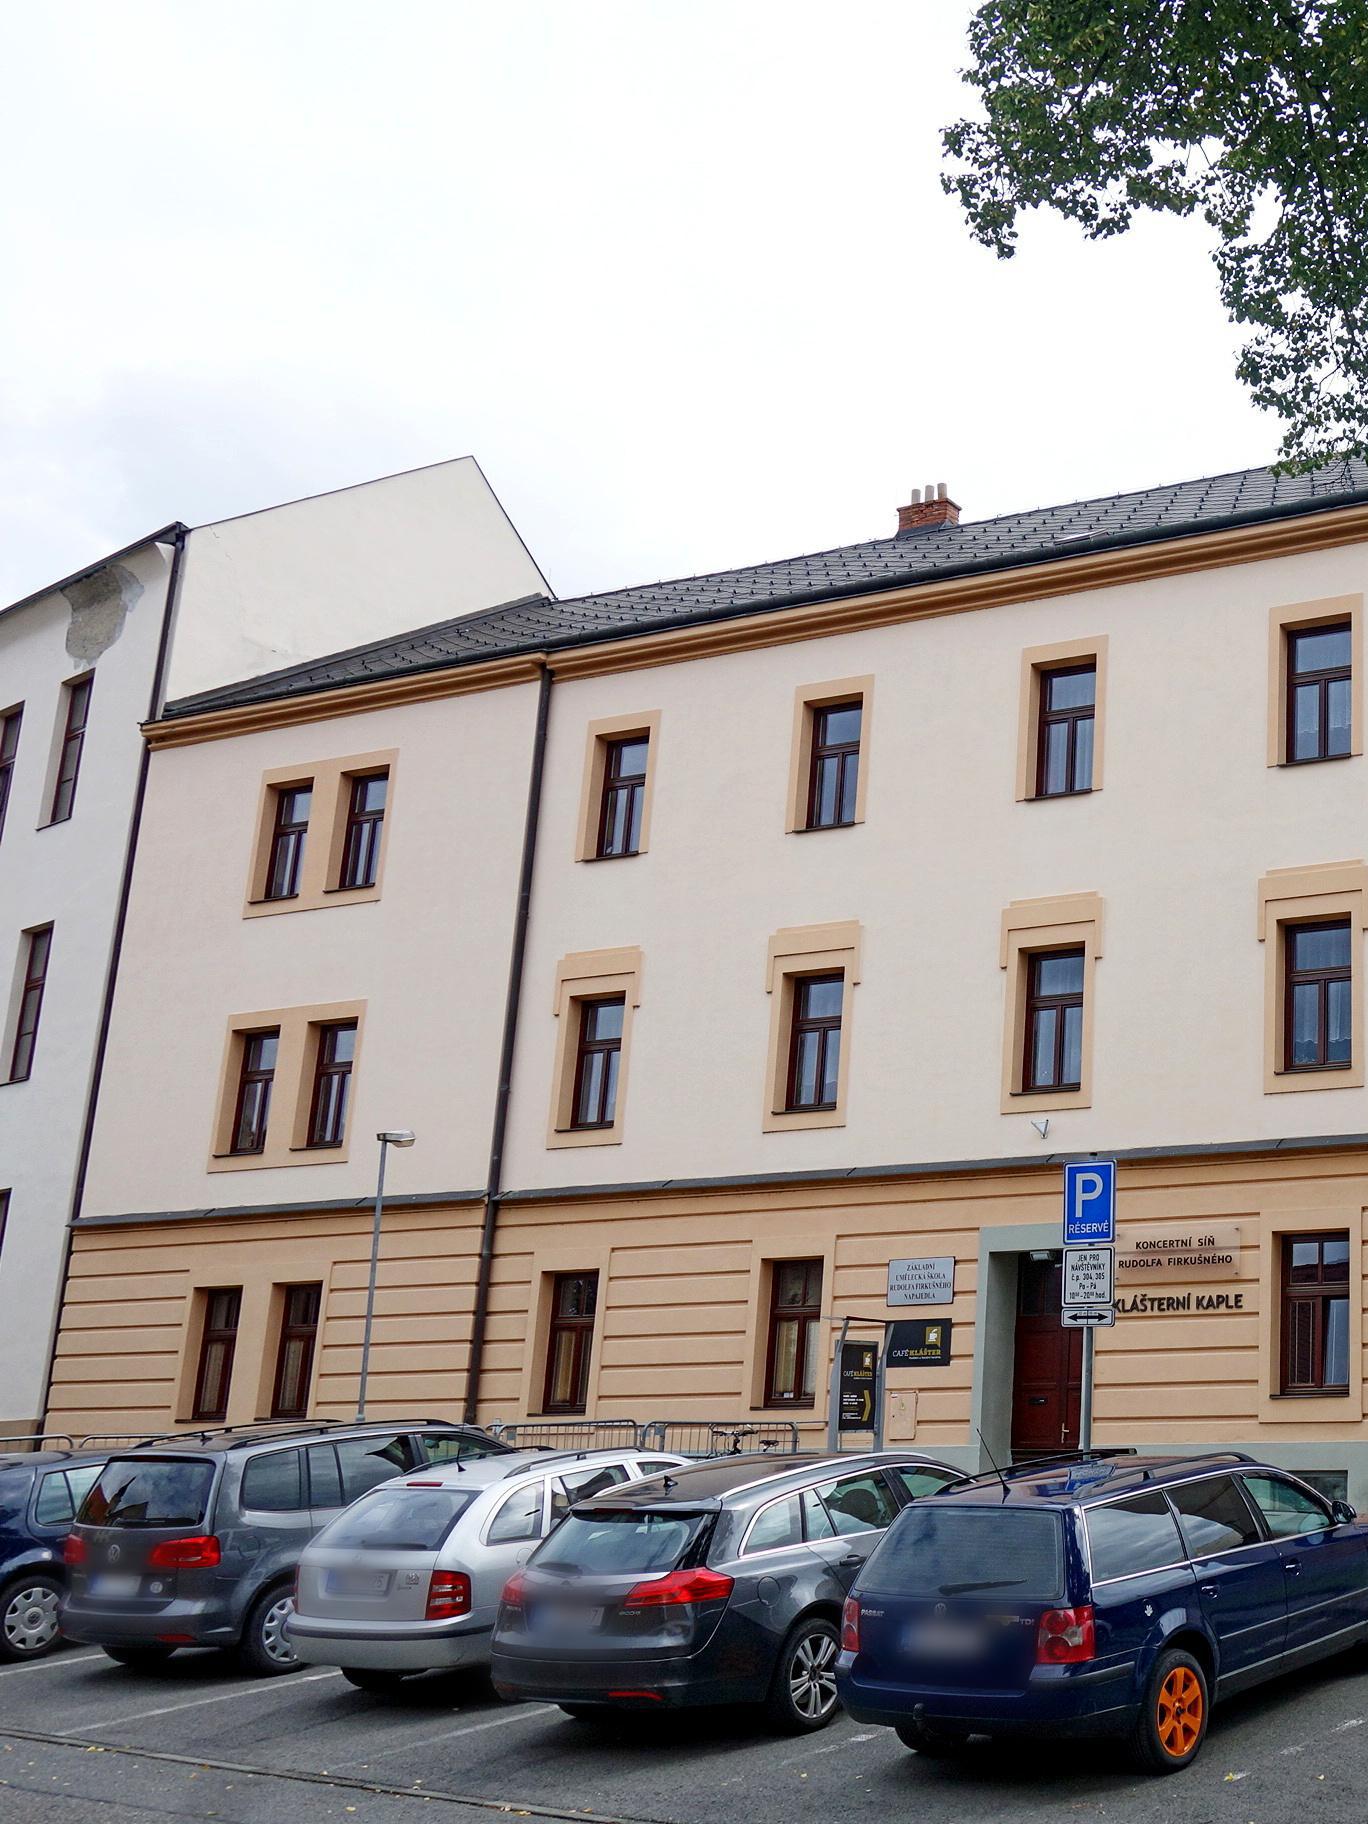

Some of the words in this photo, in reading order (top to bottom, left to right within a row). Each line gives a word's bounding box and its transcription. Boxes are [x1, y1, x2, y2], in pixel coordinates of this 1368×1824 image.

[1075, 1172, 1103, 1218] P
[1068, 1220, 1109, 1234] RÉSERVÉ
[1135, 1236, 1192, 1250] KONCERTNÍ
[1197, 1236, 1215, 1247] SÍŇ
[1077, 1254, 1088, 1262] JEN
[1089, 1253, 1100, 1262] PRO
[1118, 1258, 1162, 1269] RUDOLFA
[1167, 1253, 1233, 1266] FIRKUŠNÉHO
[906, 1262, 936, 1272] ZÁKLADNÍ
[1071, 1262, 1105, 1272] NÁVŠTĚVNÍKY
[927, 1271, 946, 1280] ŠKOLA
[915, 1280, 952, 1290] FIRKUŠNÉHO
[904, 1292, 936, 1300] NAPAJEDLA
[1112, 1293, 1191, 1313] KLÁŠTERNÍ
[1195, 1294, 1243, 1311] KAPLE
[892, 1349, 909, 1358] CAFÉ
